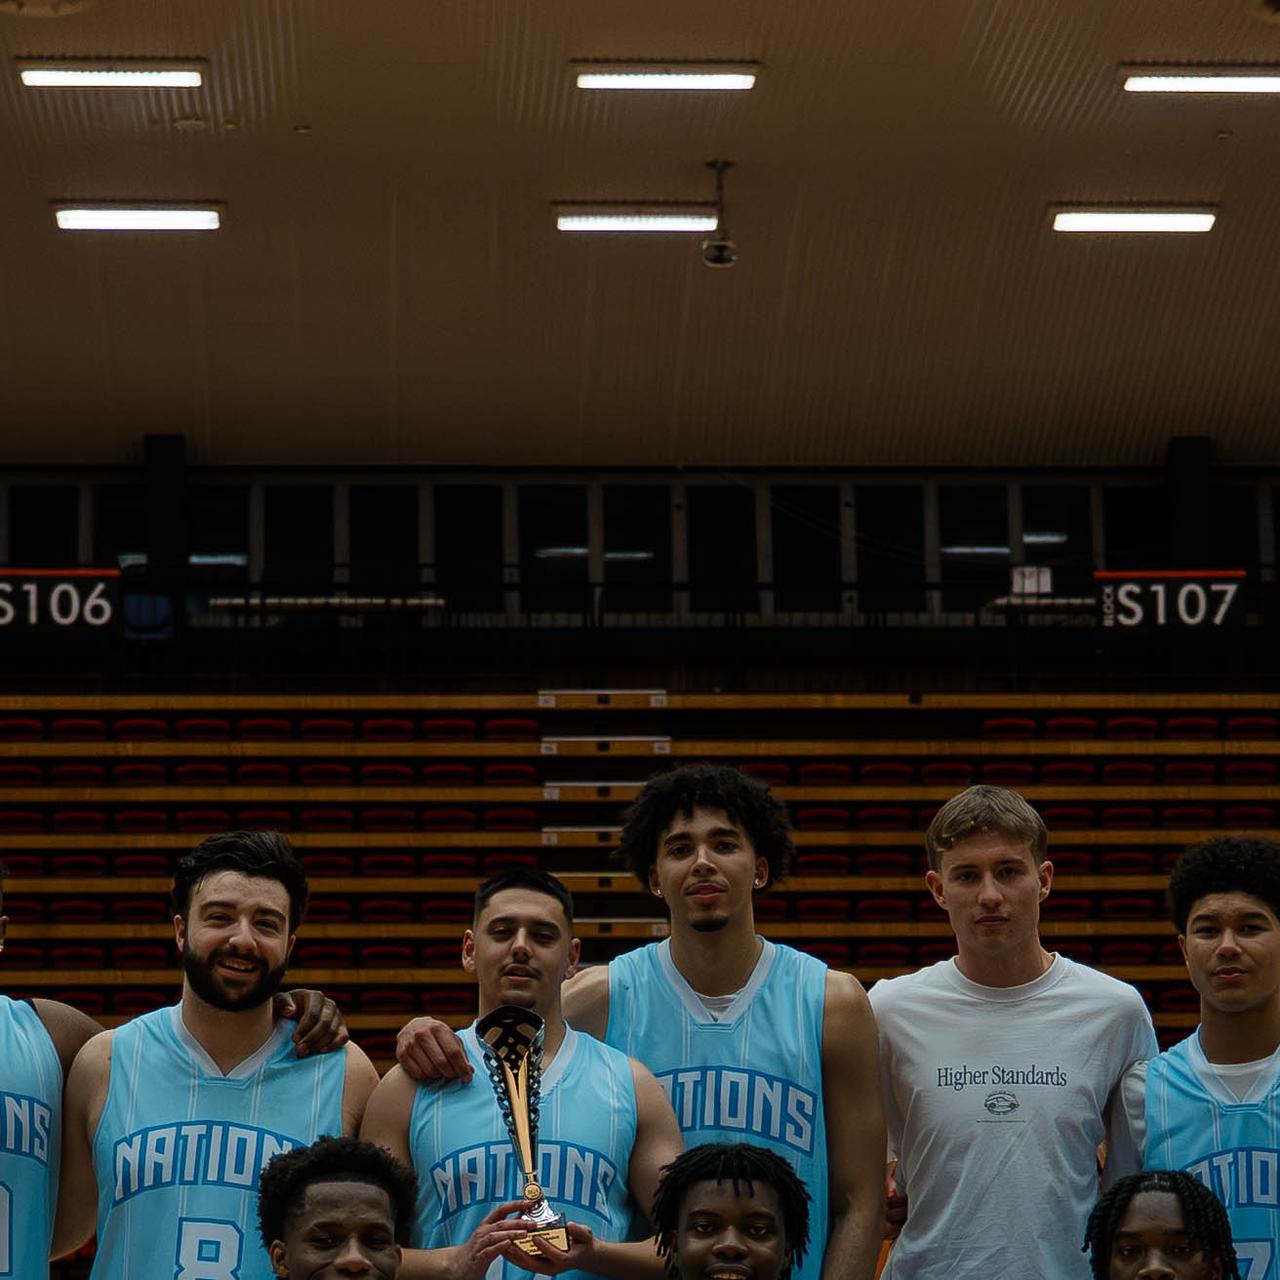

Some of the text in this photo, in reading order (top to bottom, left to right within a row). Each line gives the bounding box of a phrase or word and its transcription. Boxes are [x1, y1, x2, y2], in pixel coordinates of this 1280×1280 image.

[1116, 582, 1240, 627] S107
[937, 1064, 1067, 1092] Higher Standards
